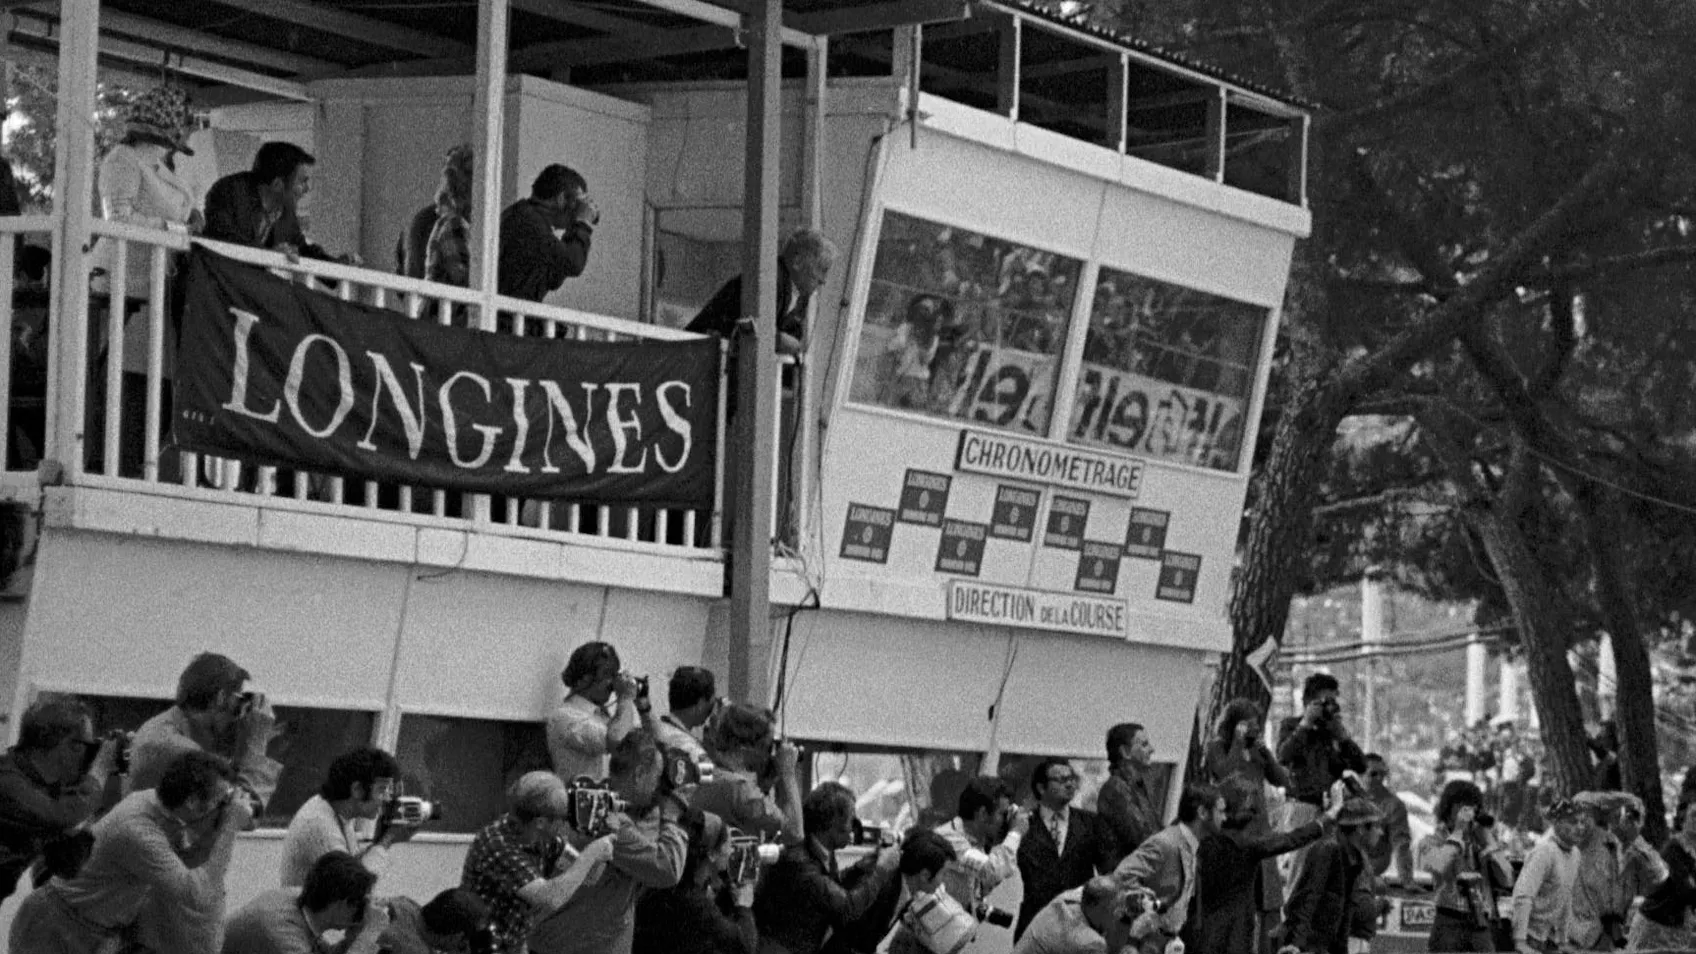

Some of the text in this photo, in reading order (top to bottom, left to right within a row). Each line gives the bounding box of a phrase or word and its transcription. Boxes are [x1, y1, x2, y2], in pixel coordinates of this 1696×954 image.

[222, 306, 693, 474] LONGINES
[965, 437, 1141, 491] CHRONOMETRAGE
[955, 586, 1036, 622] DIRECTION
[1070, 600, 1125, 632] COURSE
